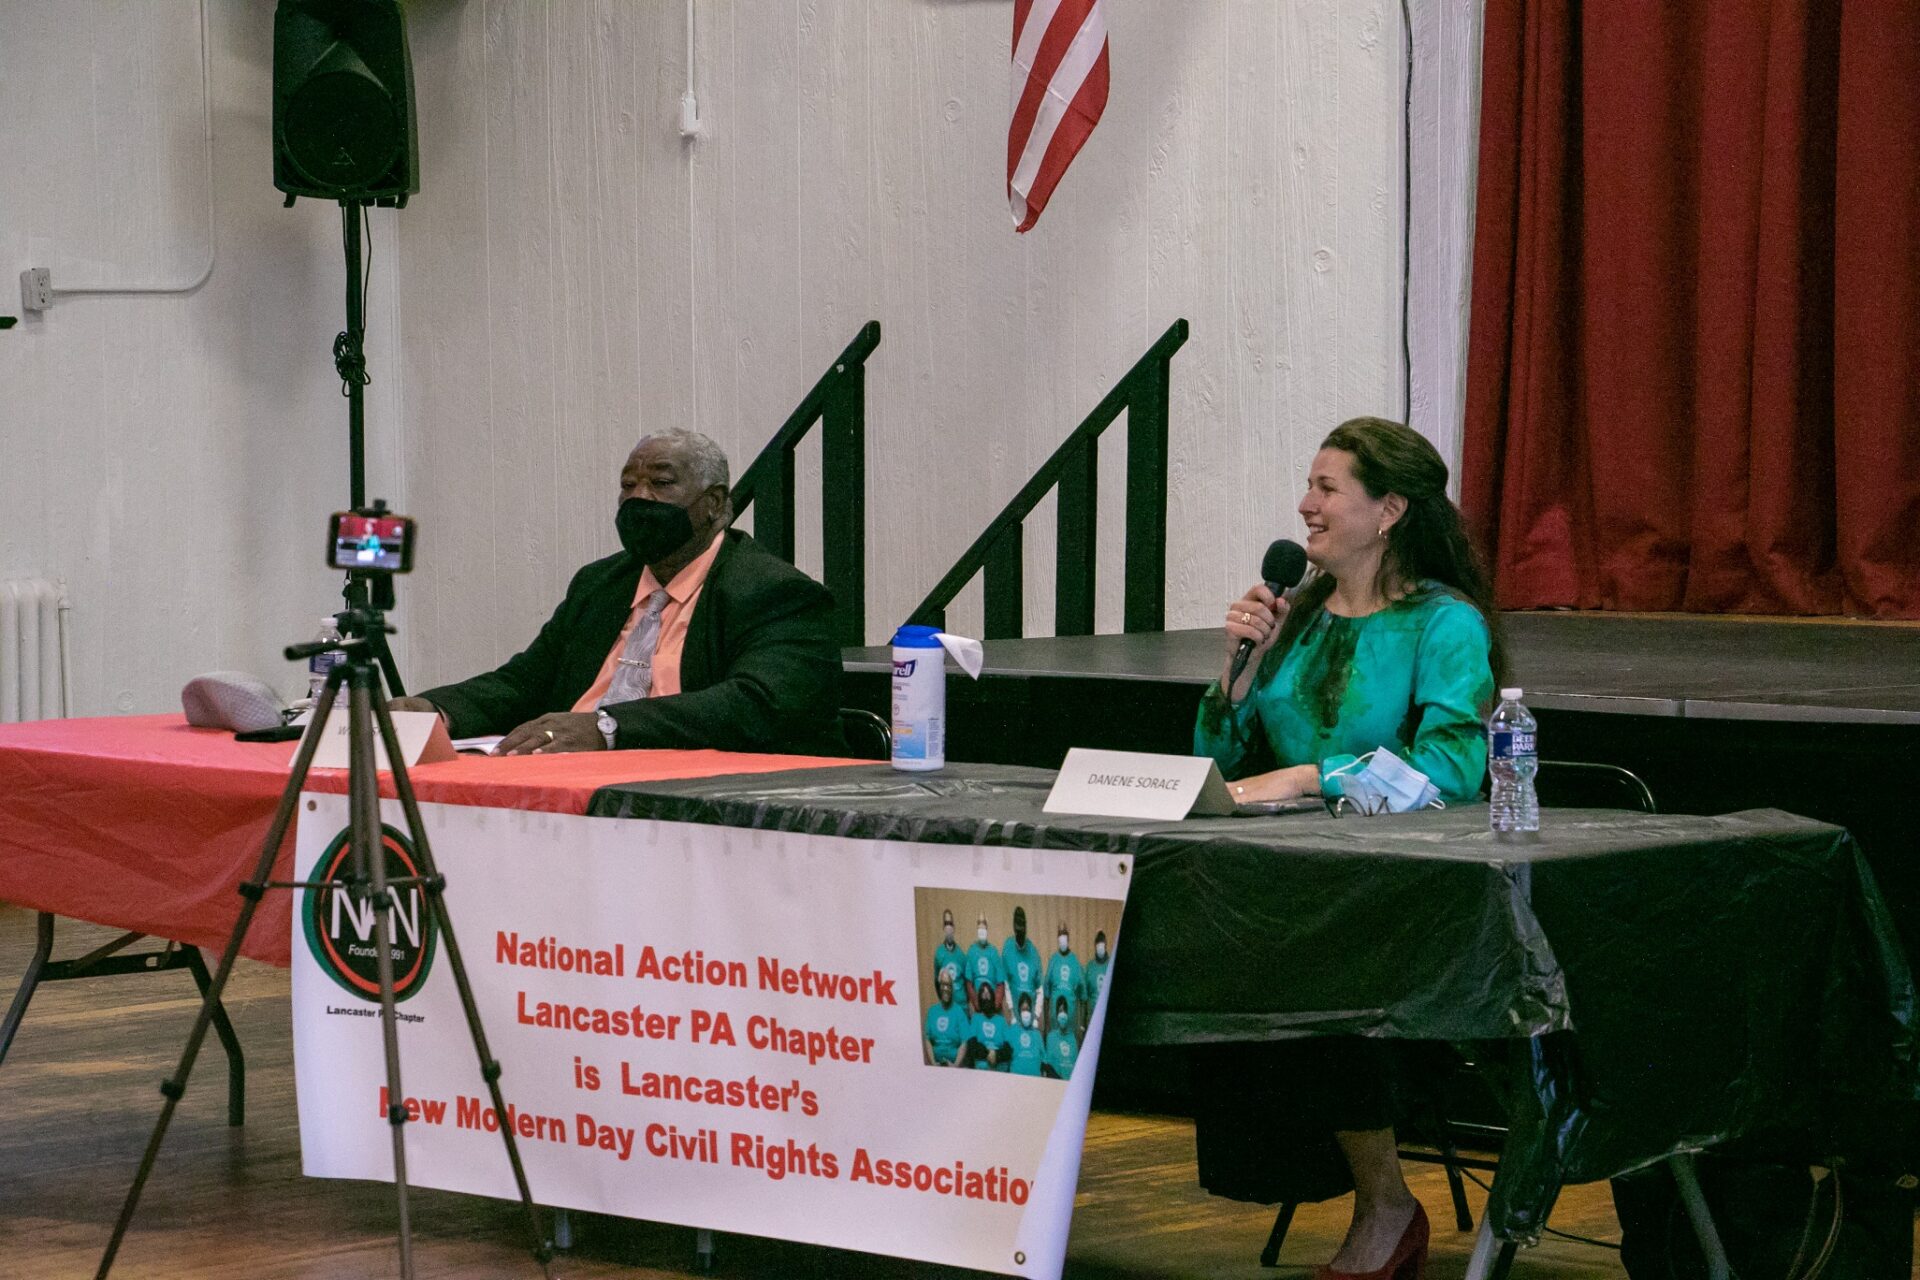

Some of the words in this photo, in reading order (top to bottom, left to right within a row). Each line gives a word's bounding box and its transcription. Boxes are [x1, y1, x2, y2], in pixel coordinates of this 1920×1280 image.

[1087, 773, 1135, 788] DANENE
[1135, 776, 1181, 791] SORACE
[390, 948, 405, 960] 991
[496, 931, 624, 977] National
[637, 946, 747, 989] Action
[758, 956, 897, 1005] Network
[326, 1005, 375, 1018] Lancaster
[394, 1010, 425, 1023] Chapter
[518, 992, 682, 1041] Lancaster
[691, 1009, 737, 1047] PA
[747, 1015, 876, 1066] Chapter
[575, 1057, 602, 1092] is
[576, 1114, 635, 1164] Day
[645, 1124, 719, 1165] Civil
[731, 1132, 840, 1181] Rights
[850, 1148, 1034, 1206] Associatio
